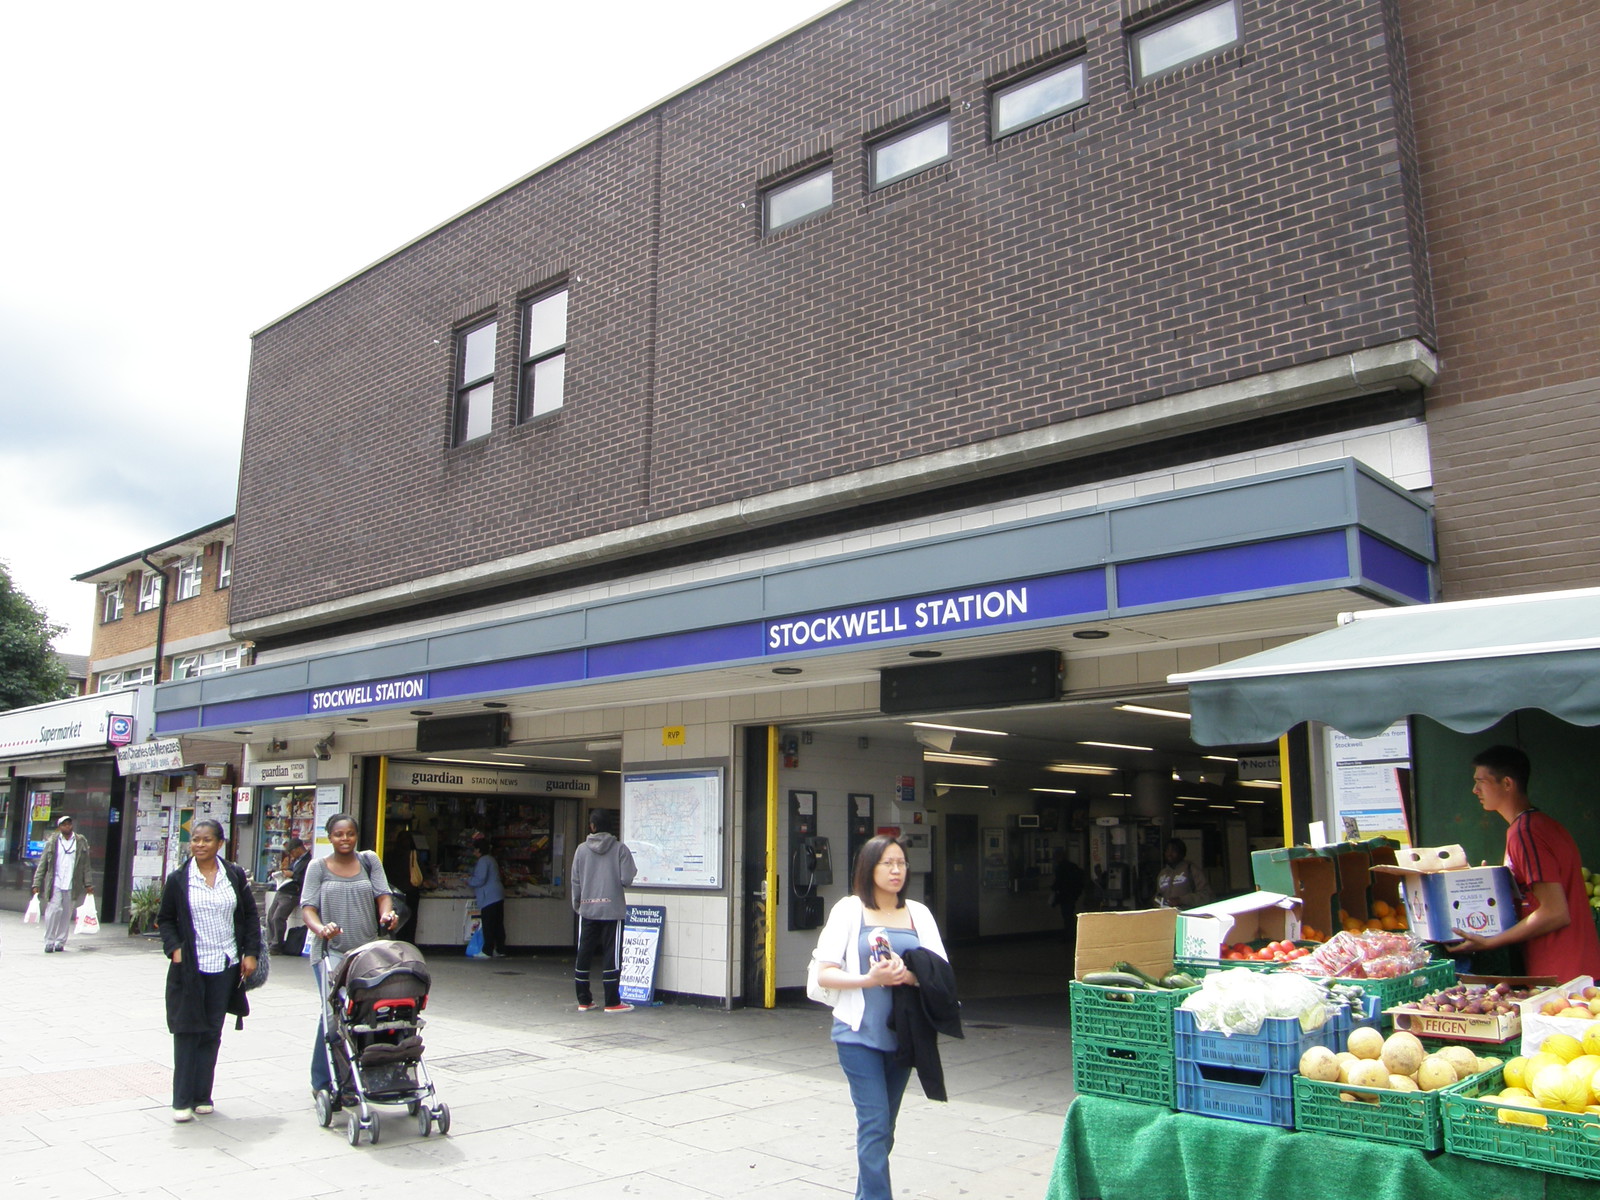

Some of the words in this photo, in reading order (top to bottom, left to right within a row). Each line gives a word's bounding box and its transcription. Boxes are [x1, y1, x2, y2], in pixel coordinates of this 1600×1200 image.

[769, 607, 907, 649] STOCKWELL
[915, 587, 1028, 628] STATION
[313, 686, 372, 710] STOCKWELL
[375, 679, 423, 701] STATION
[39, 721, 82, 746] Supermarket
[667, 731, 680, 739] RVP
[155, 742, 180, 755] Menezes
[261, 765, 289, 781] guardian
[411, 768, 463, 785] guardian
[471, 776, 497, 785] STATION
[500, 778, 518, 786] NEWS
[545, 778, 590, 791] guardian
[238, 792, 250, 801] LFB
[631, 907, 660, 917] Evening
[629, 915, 662, 924] Standard
[625, 938, 650, 946] INSULT
[634, 947, 649, 955] THE
[622, 991, 646, 999] Standard
[623, 986, 644, 994] Evening
[1425, 1019, 1467, 1034] FEIGEN
